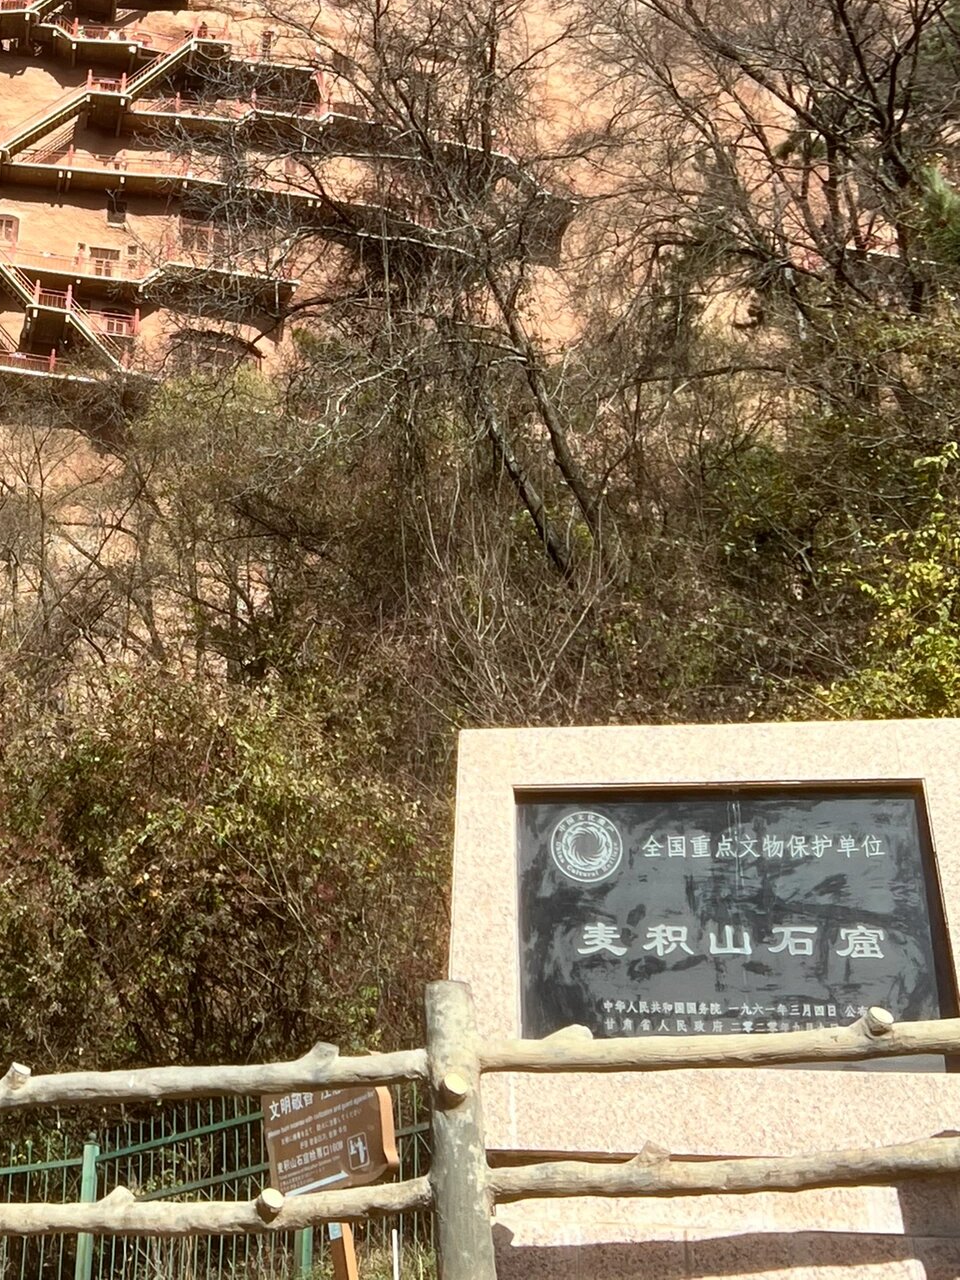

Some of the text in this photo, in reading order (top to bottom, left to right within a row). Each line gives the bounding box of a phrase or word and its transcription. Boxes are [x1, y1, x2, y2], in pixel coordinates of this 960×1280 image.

[642, 834, 887, 858] 全国重点文物保护单位
[577, 922, 886, 959] 麦积山石窟
[603, 1000, 723, 1016] 中华人民共和国国务院
[728, 1002, 837, 1018] 一九六一年三月四日
[604, 1019, 724, 1033] 甘肃省人民政府
